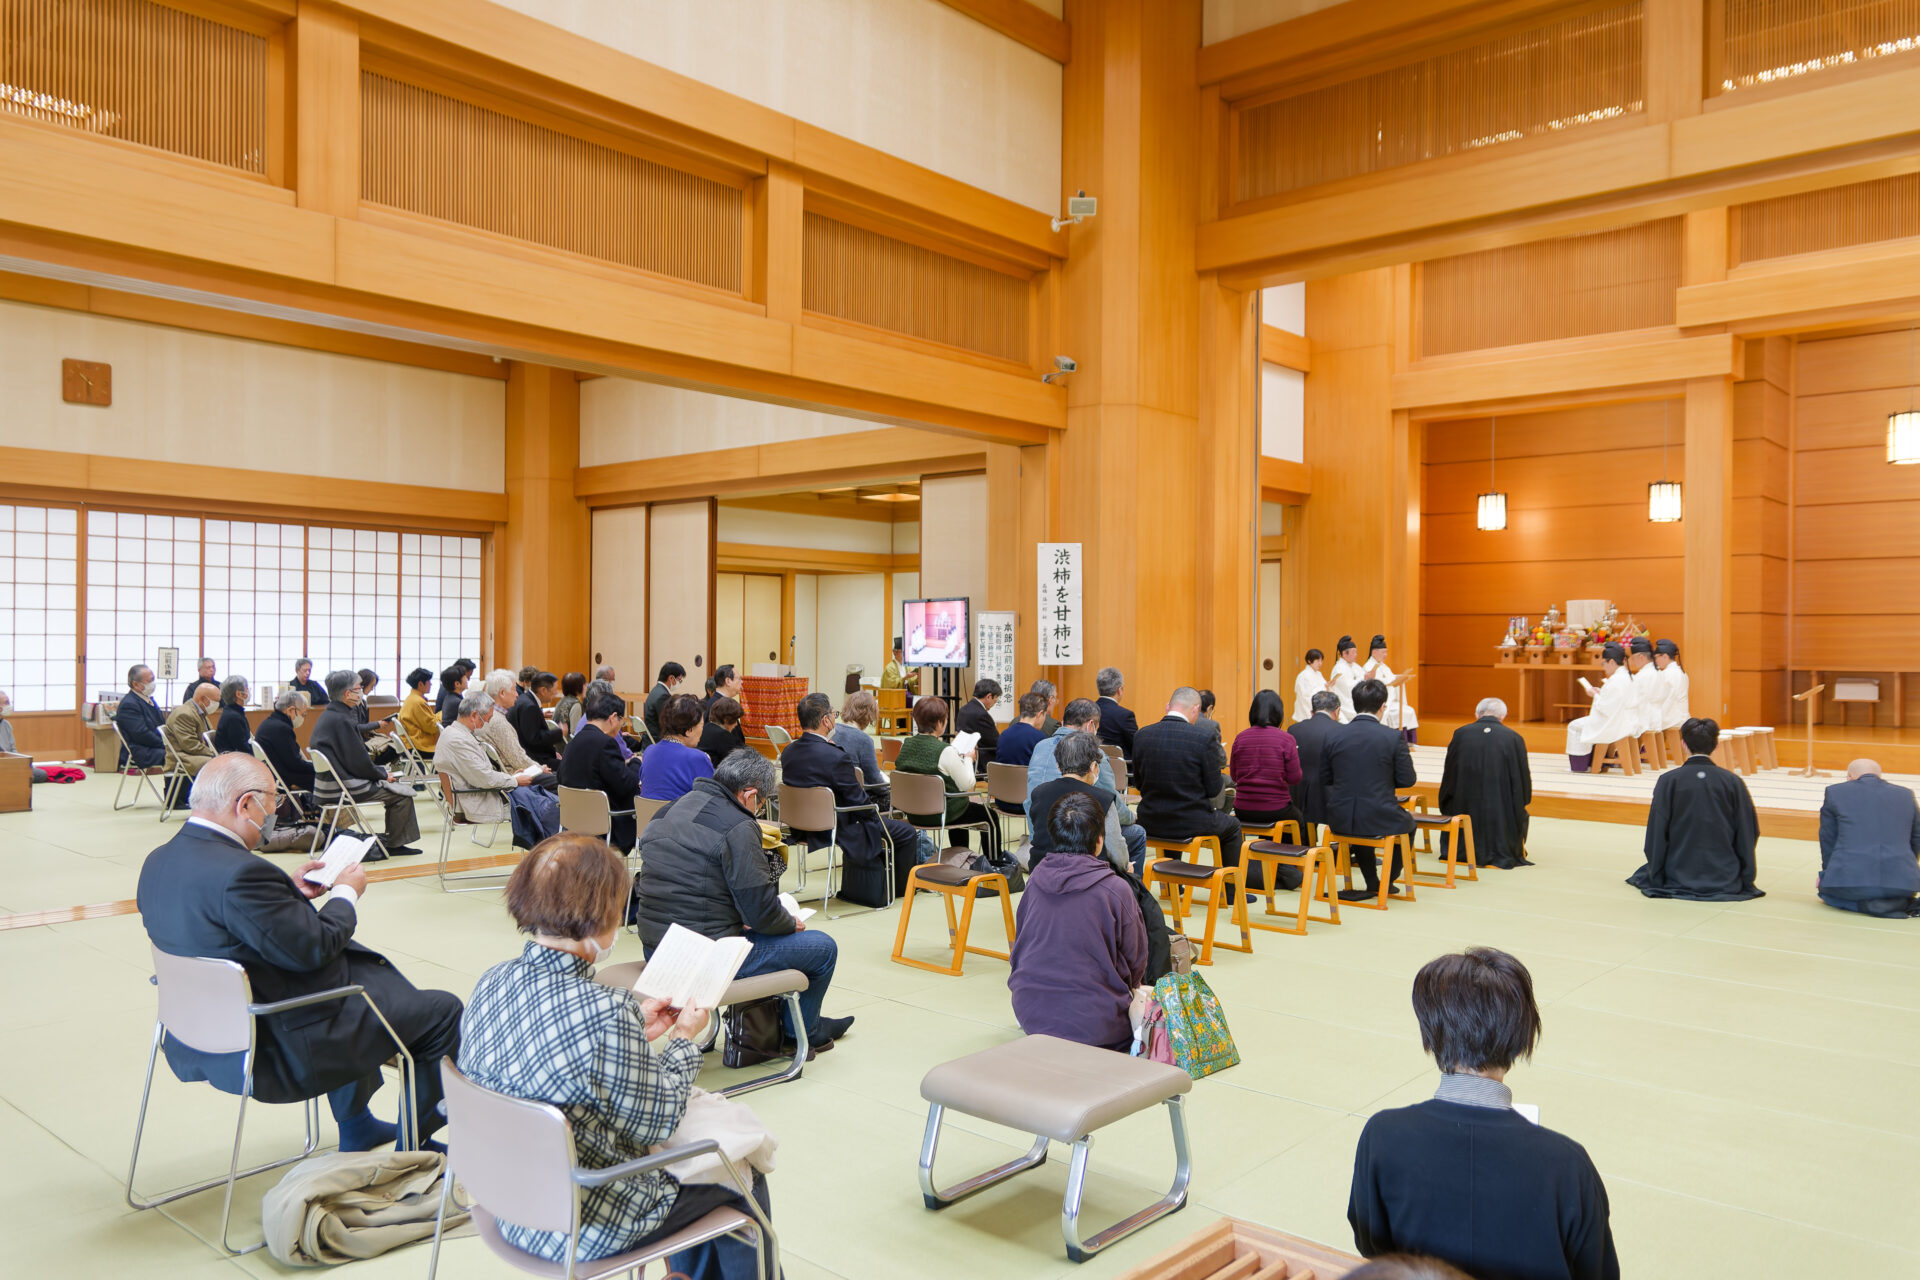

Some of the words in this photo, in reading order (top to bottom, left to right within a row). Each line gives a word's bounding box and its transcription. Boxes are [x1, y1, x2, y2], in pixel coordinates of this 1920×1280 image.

[1053, 549, 1071, 658] 渋柿を甘柿に
[1004, 621, 1013, 703] 本部広前の御祈念
